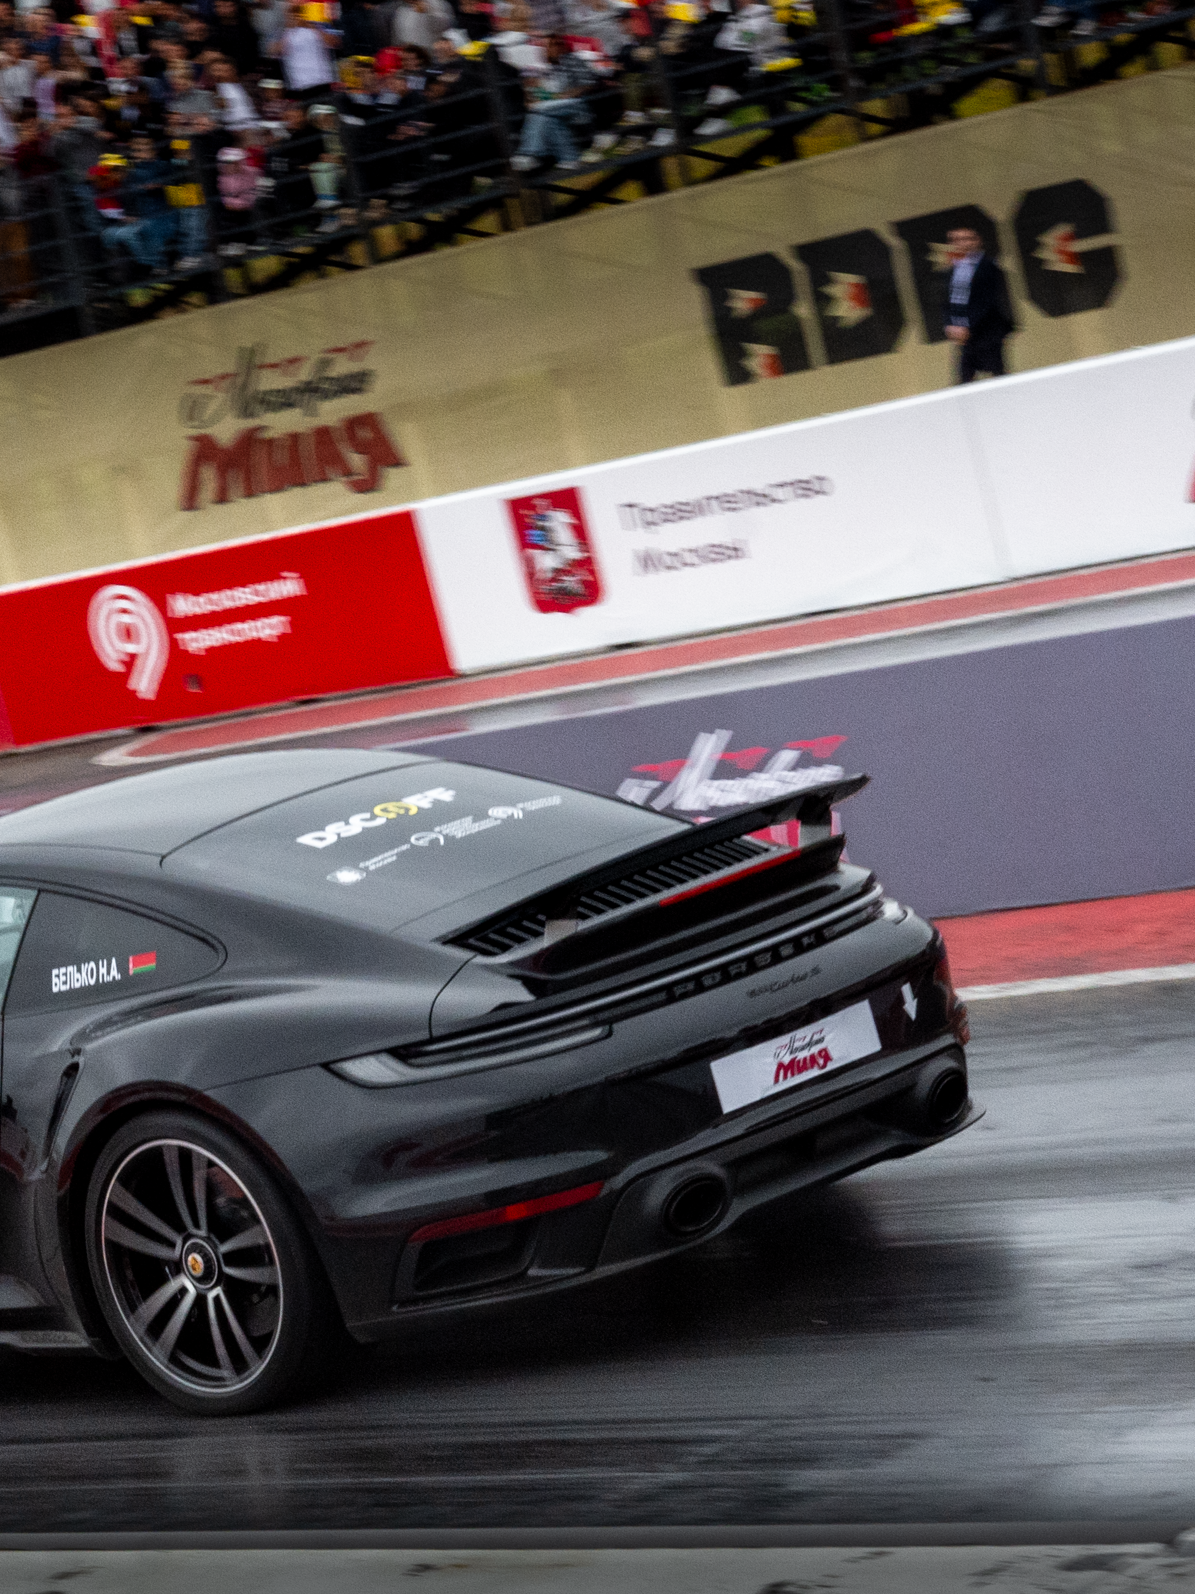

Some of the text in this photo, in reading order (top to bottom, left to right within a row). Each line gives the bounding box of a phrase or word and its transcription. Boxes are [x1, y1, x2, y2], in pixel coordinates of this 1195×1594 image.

[52, 957, 121, 993] БЕЛЬКО Н.А.
[773, 1047, 832, 1084] Миля
